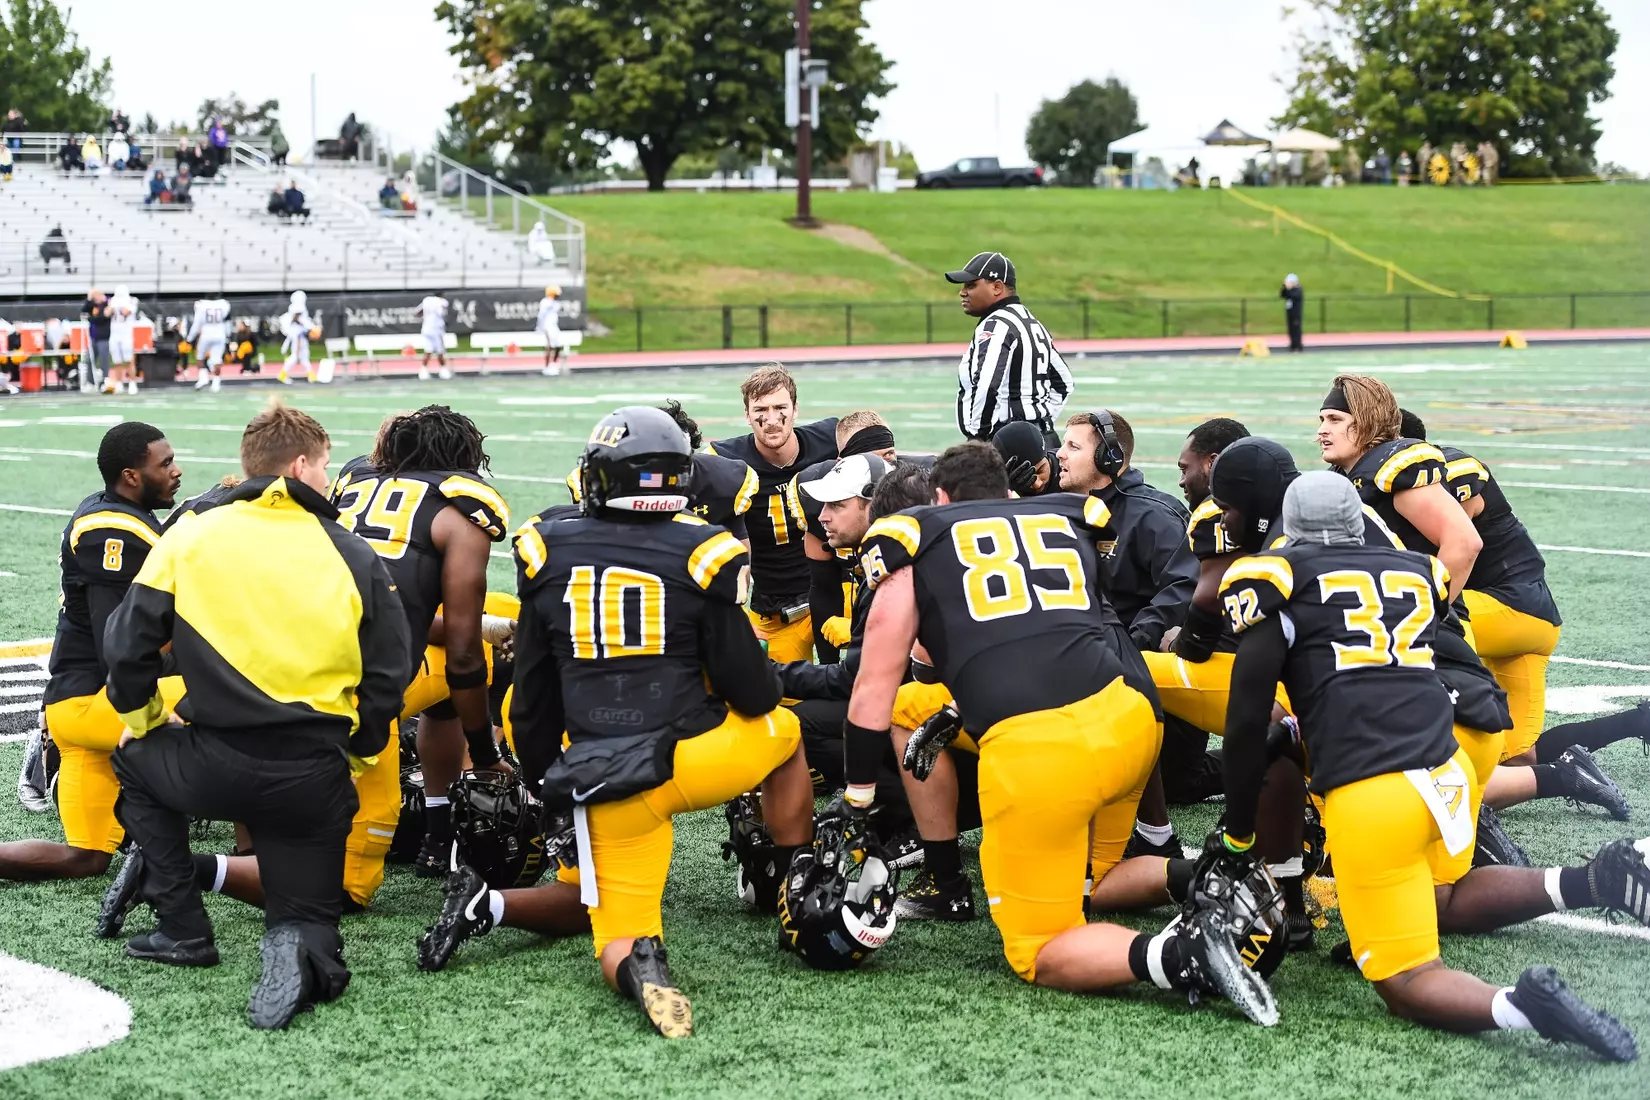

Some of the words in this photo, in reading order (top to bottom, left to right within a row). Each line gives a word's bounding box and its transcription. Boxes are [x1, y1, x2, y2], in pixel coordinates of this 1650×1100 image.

[632, 499, 683, 511] Riddell
[103, 538, 124, 571] 8
[951, 513, 1091, 622] 85
[563, 565, 666, 660] 10
[1224, 587, 1267, 634] 32
[1317, 570, 1435, 671] 32
